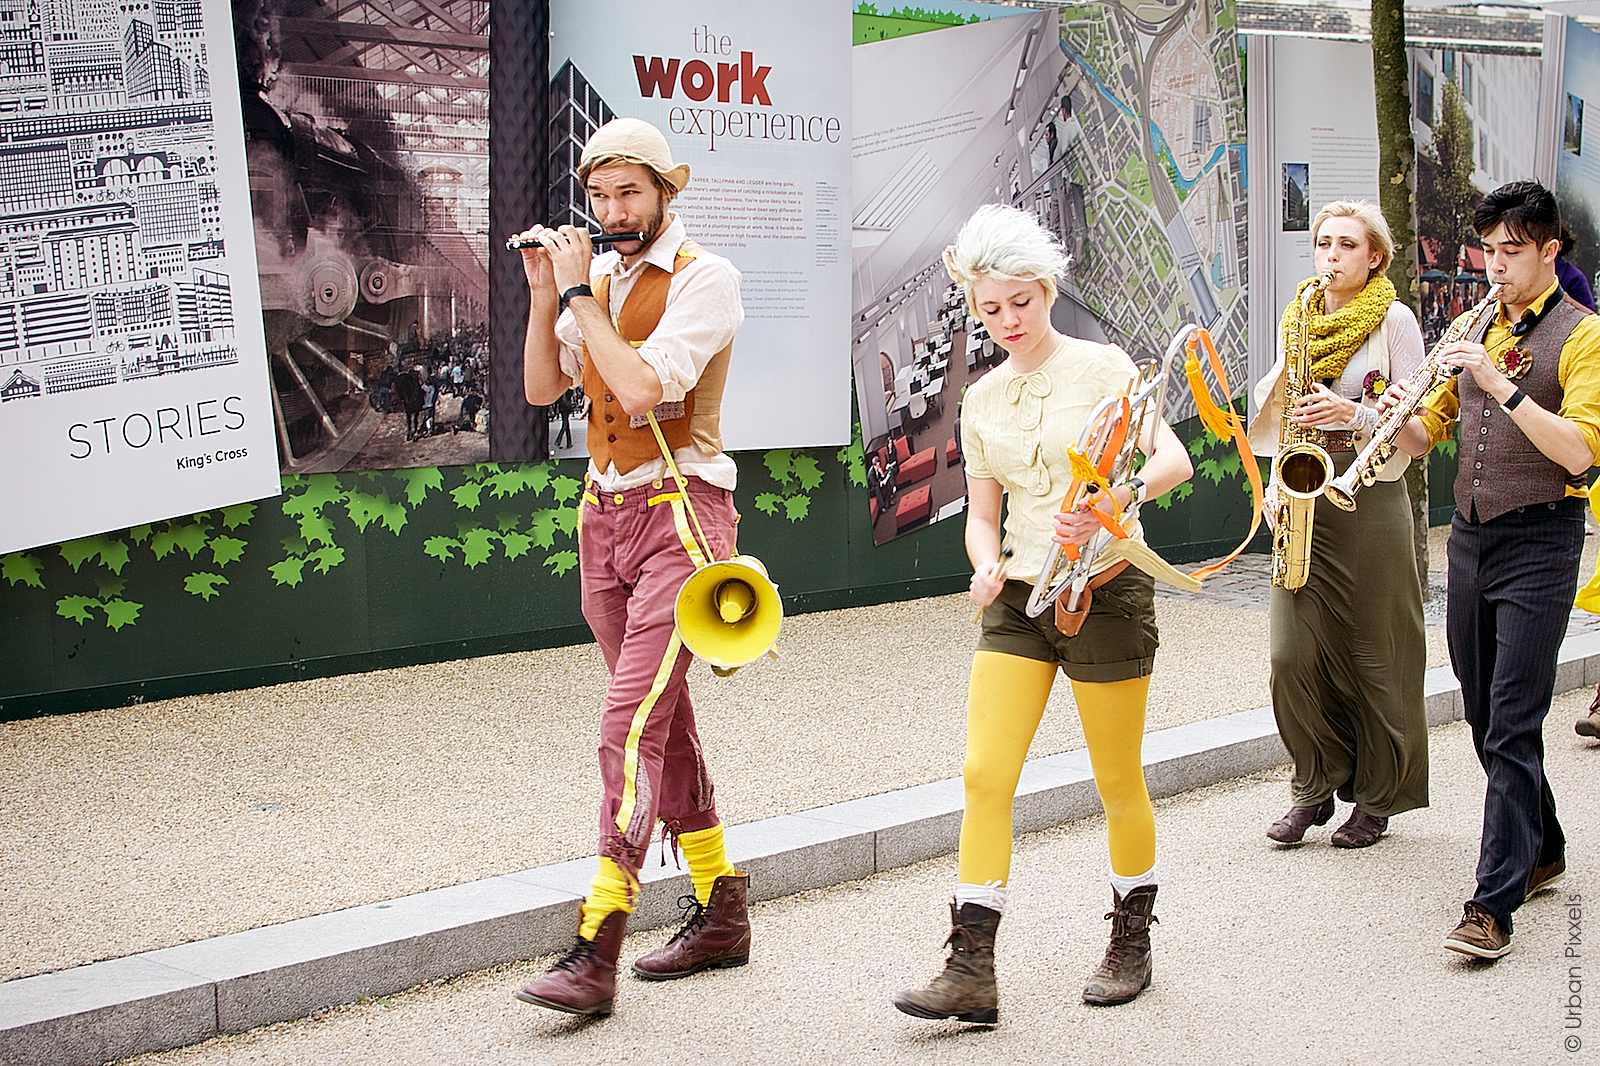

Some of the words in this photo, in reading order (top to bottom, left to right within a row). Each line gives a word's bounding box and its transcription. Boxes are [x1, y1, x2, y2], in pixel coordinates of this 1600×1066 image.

[692, 25, 732, 56] the
[632, 51, 772, 106] work
[668, 106, 840, 152] experience
[68, 396, 245, 458] STORIES
[177, 454, 212, 470] King's
[215, 446, 248, 462] Cross
